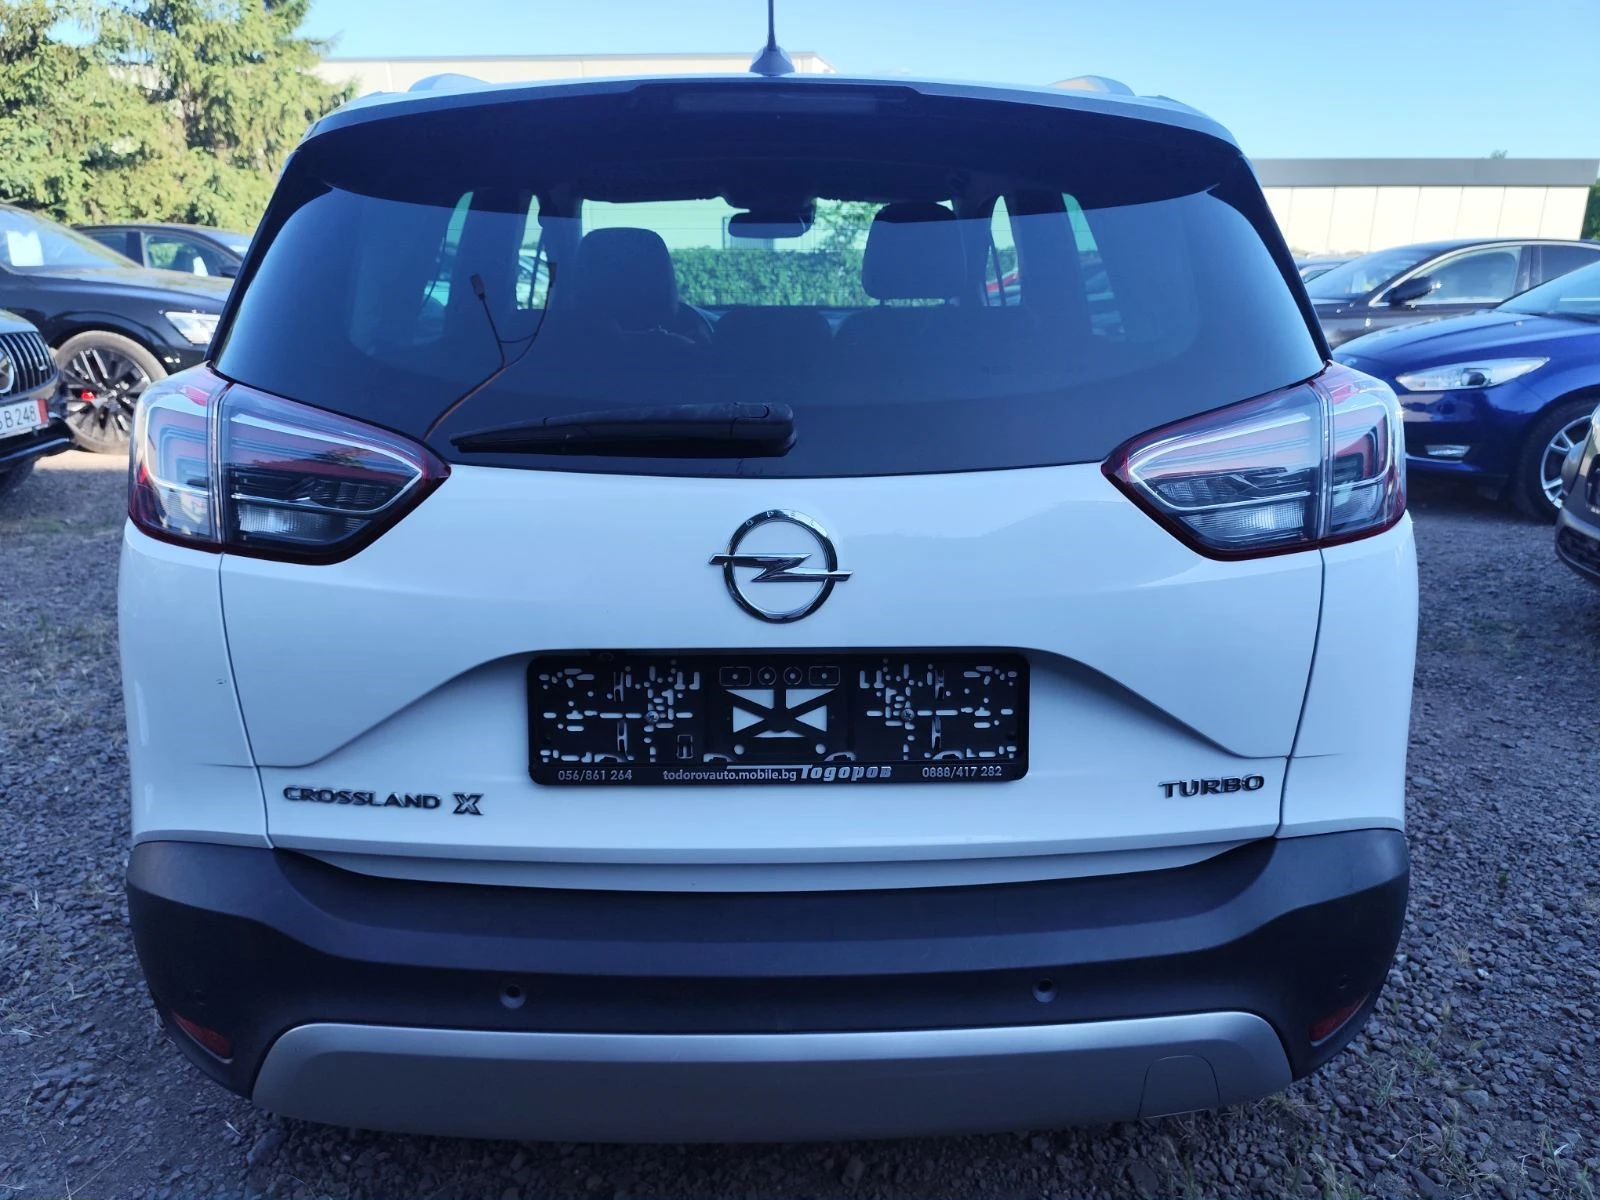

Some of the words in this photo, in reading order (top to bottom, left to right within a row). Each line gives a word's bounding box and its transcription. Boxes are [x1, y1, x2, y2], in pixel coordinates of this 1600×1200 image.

[558, 769, 606, 781] 056/861
[611, 769, 633, 780] 264
[662, 768, 797, 782] todorovauto.mobile.bg
[922, 766, 978, 779] 0888/417
[981, 765, 1003, 777] 282
[1158, 774, 1265, 799] TURBO
[283, 785, 442, 810] CROSSLAND
[452, 792, 485, 815] X
